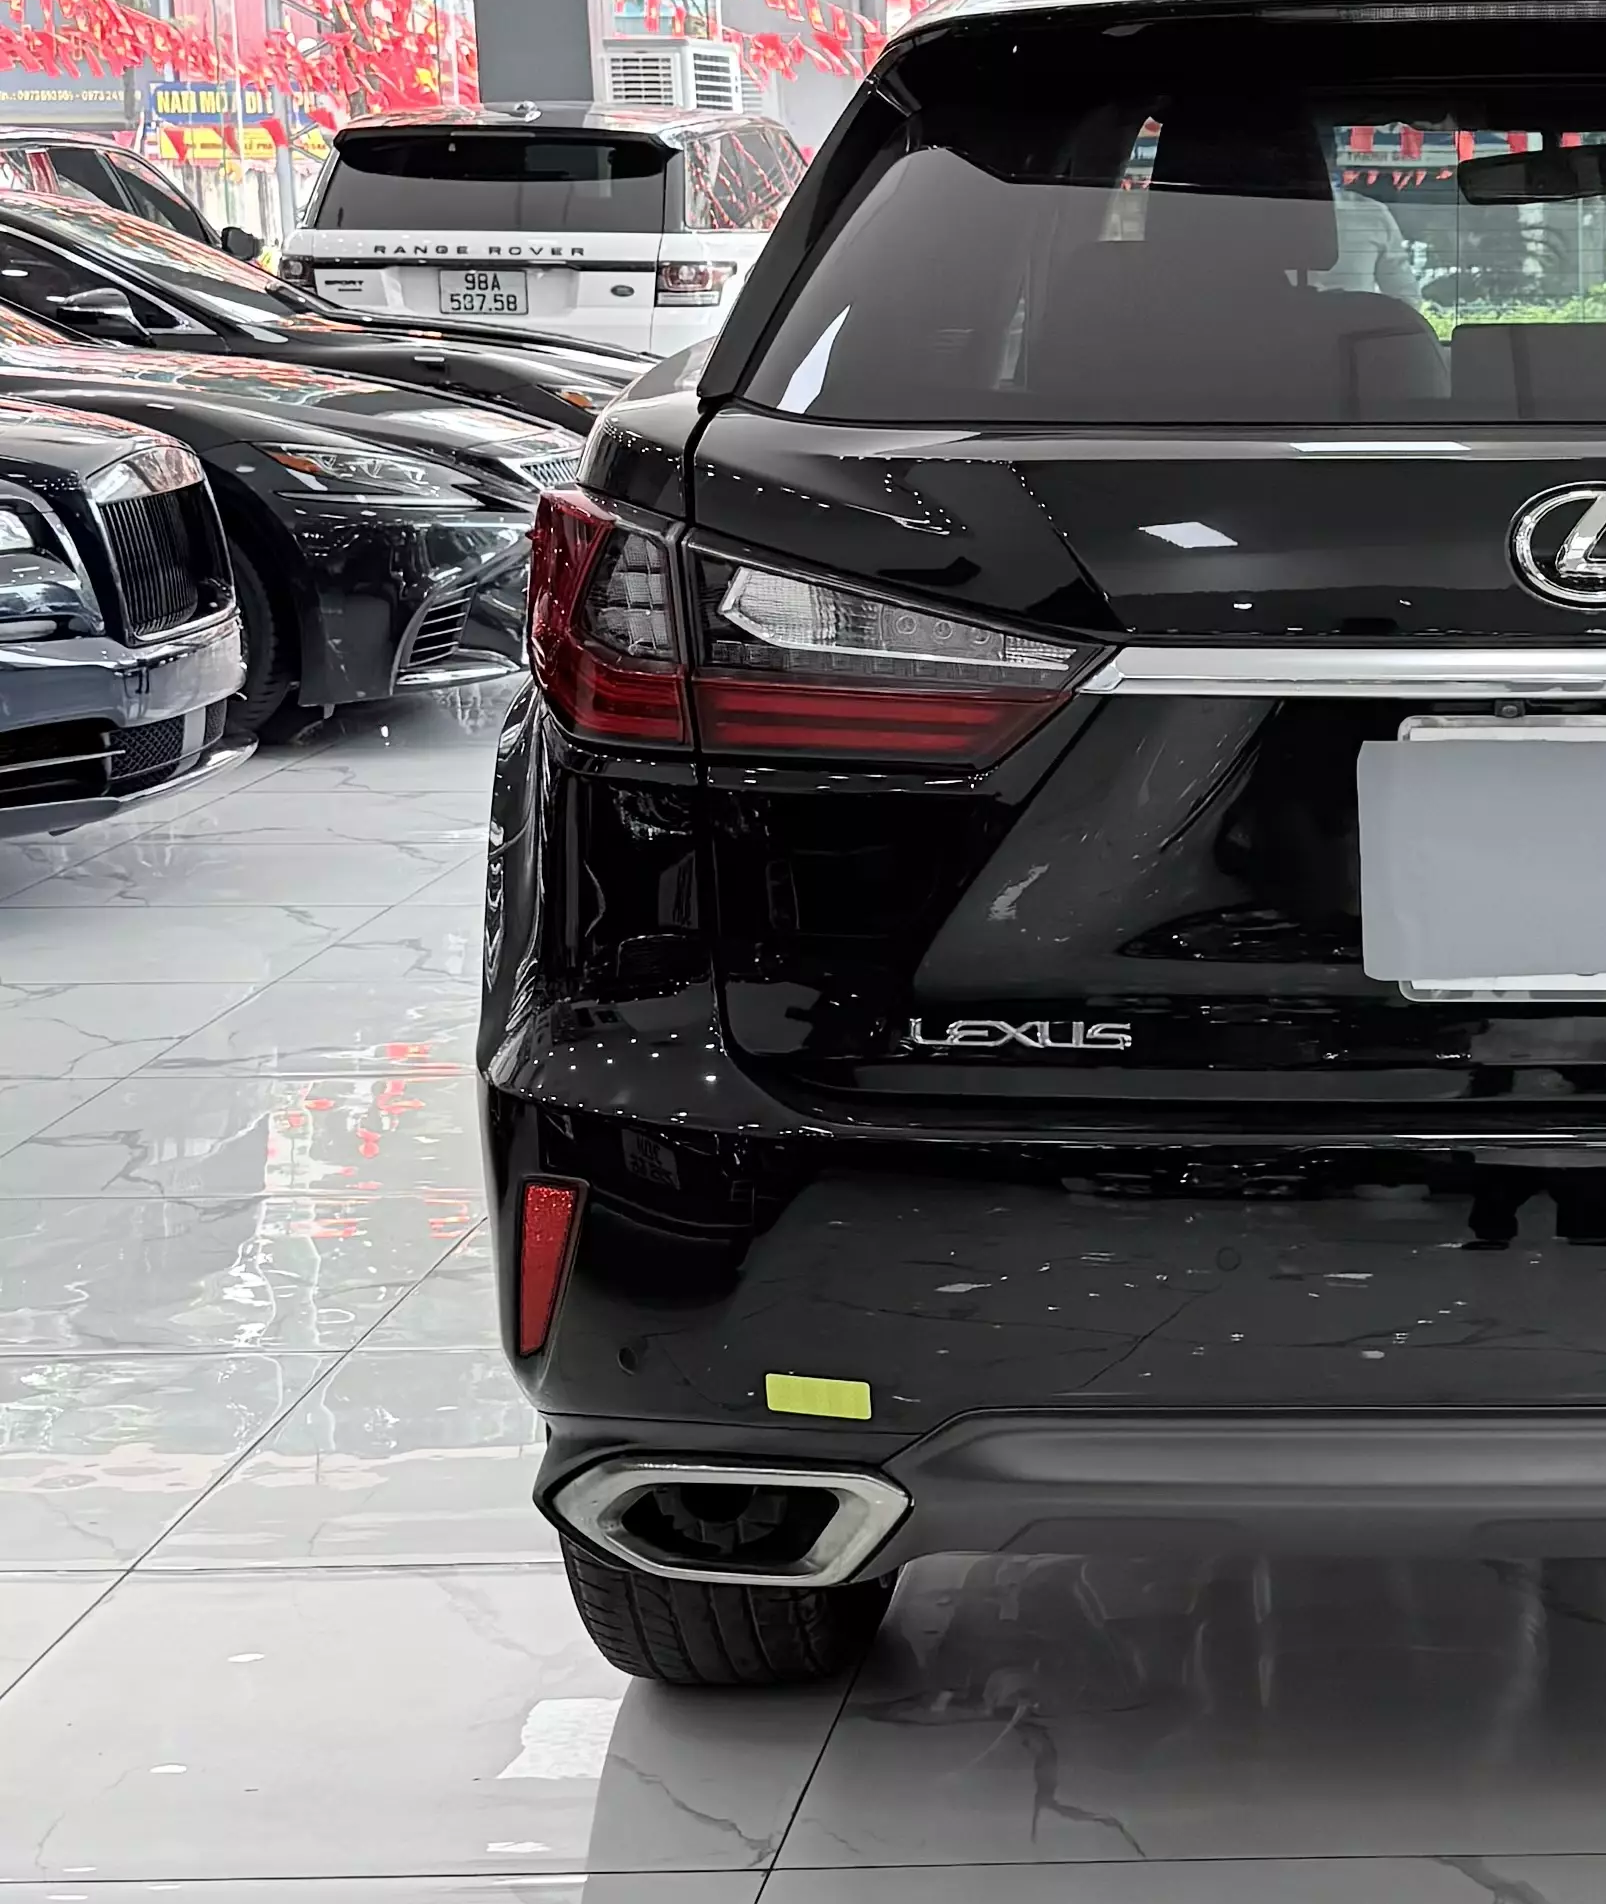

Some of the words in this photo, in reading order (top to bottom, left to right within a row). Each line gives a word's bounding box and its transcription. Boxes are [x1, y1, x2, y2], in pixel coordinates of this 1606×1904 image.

[374, 245, 469, 255] RANGE
[489, 246, 585, 256] ROVER
[464, 273, 502, 291] 98A
[909, 1018, 1132, 1050] LEXUS
